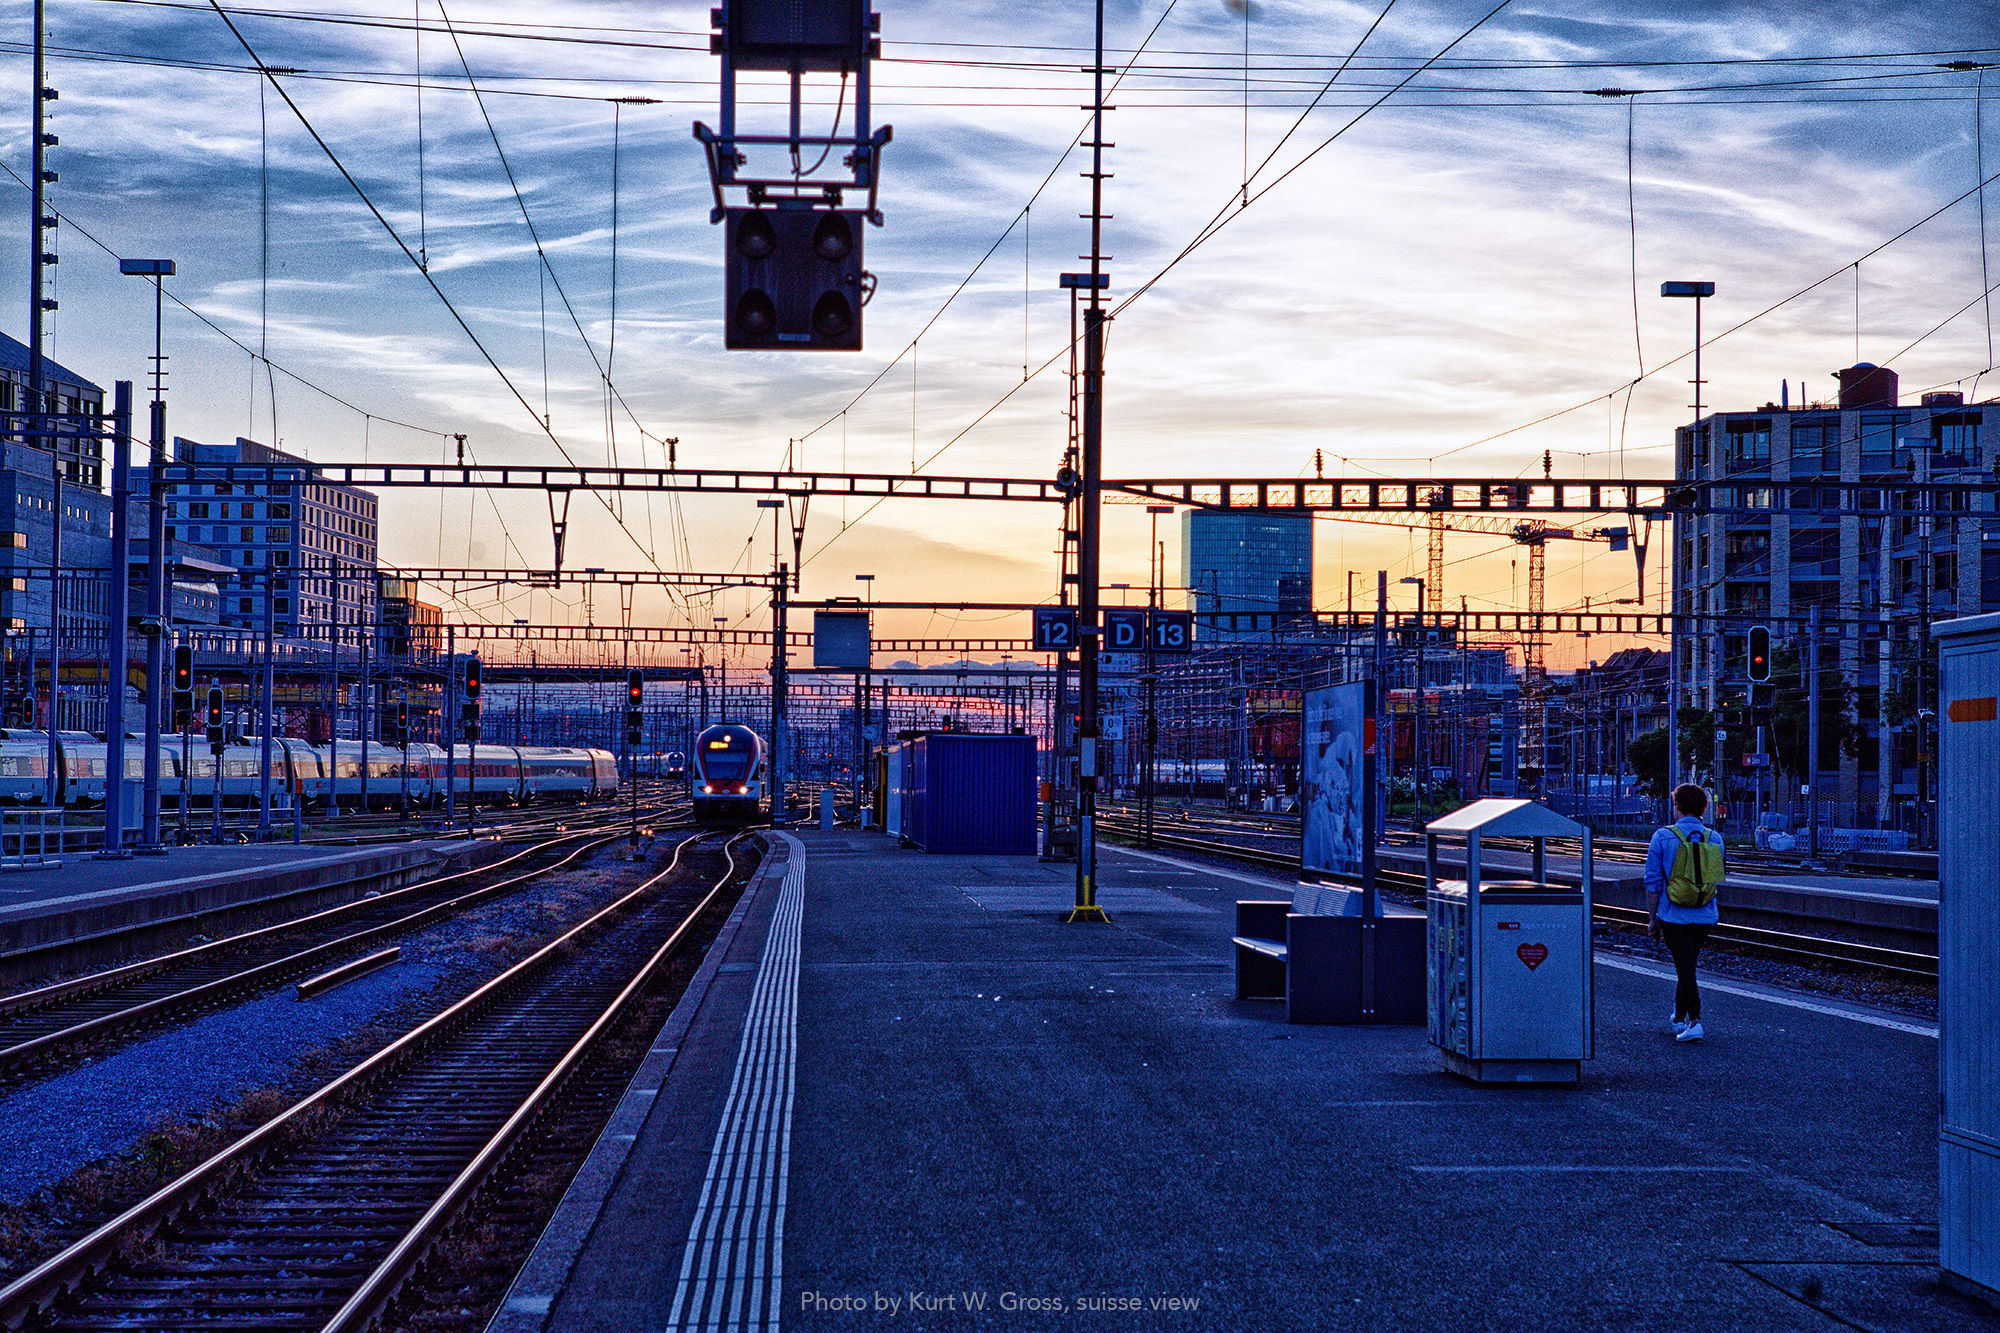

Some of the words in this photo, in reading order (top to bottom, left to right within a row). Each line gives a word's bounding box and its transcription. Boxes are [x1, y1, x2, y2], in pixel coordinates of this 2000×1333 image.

[1041, 622, 1069, 644] 12
[1116, 623, 1135, 645] D
[1156, 623, 1184, 646] 13
